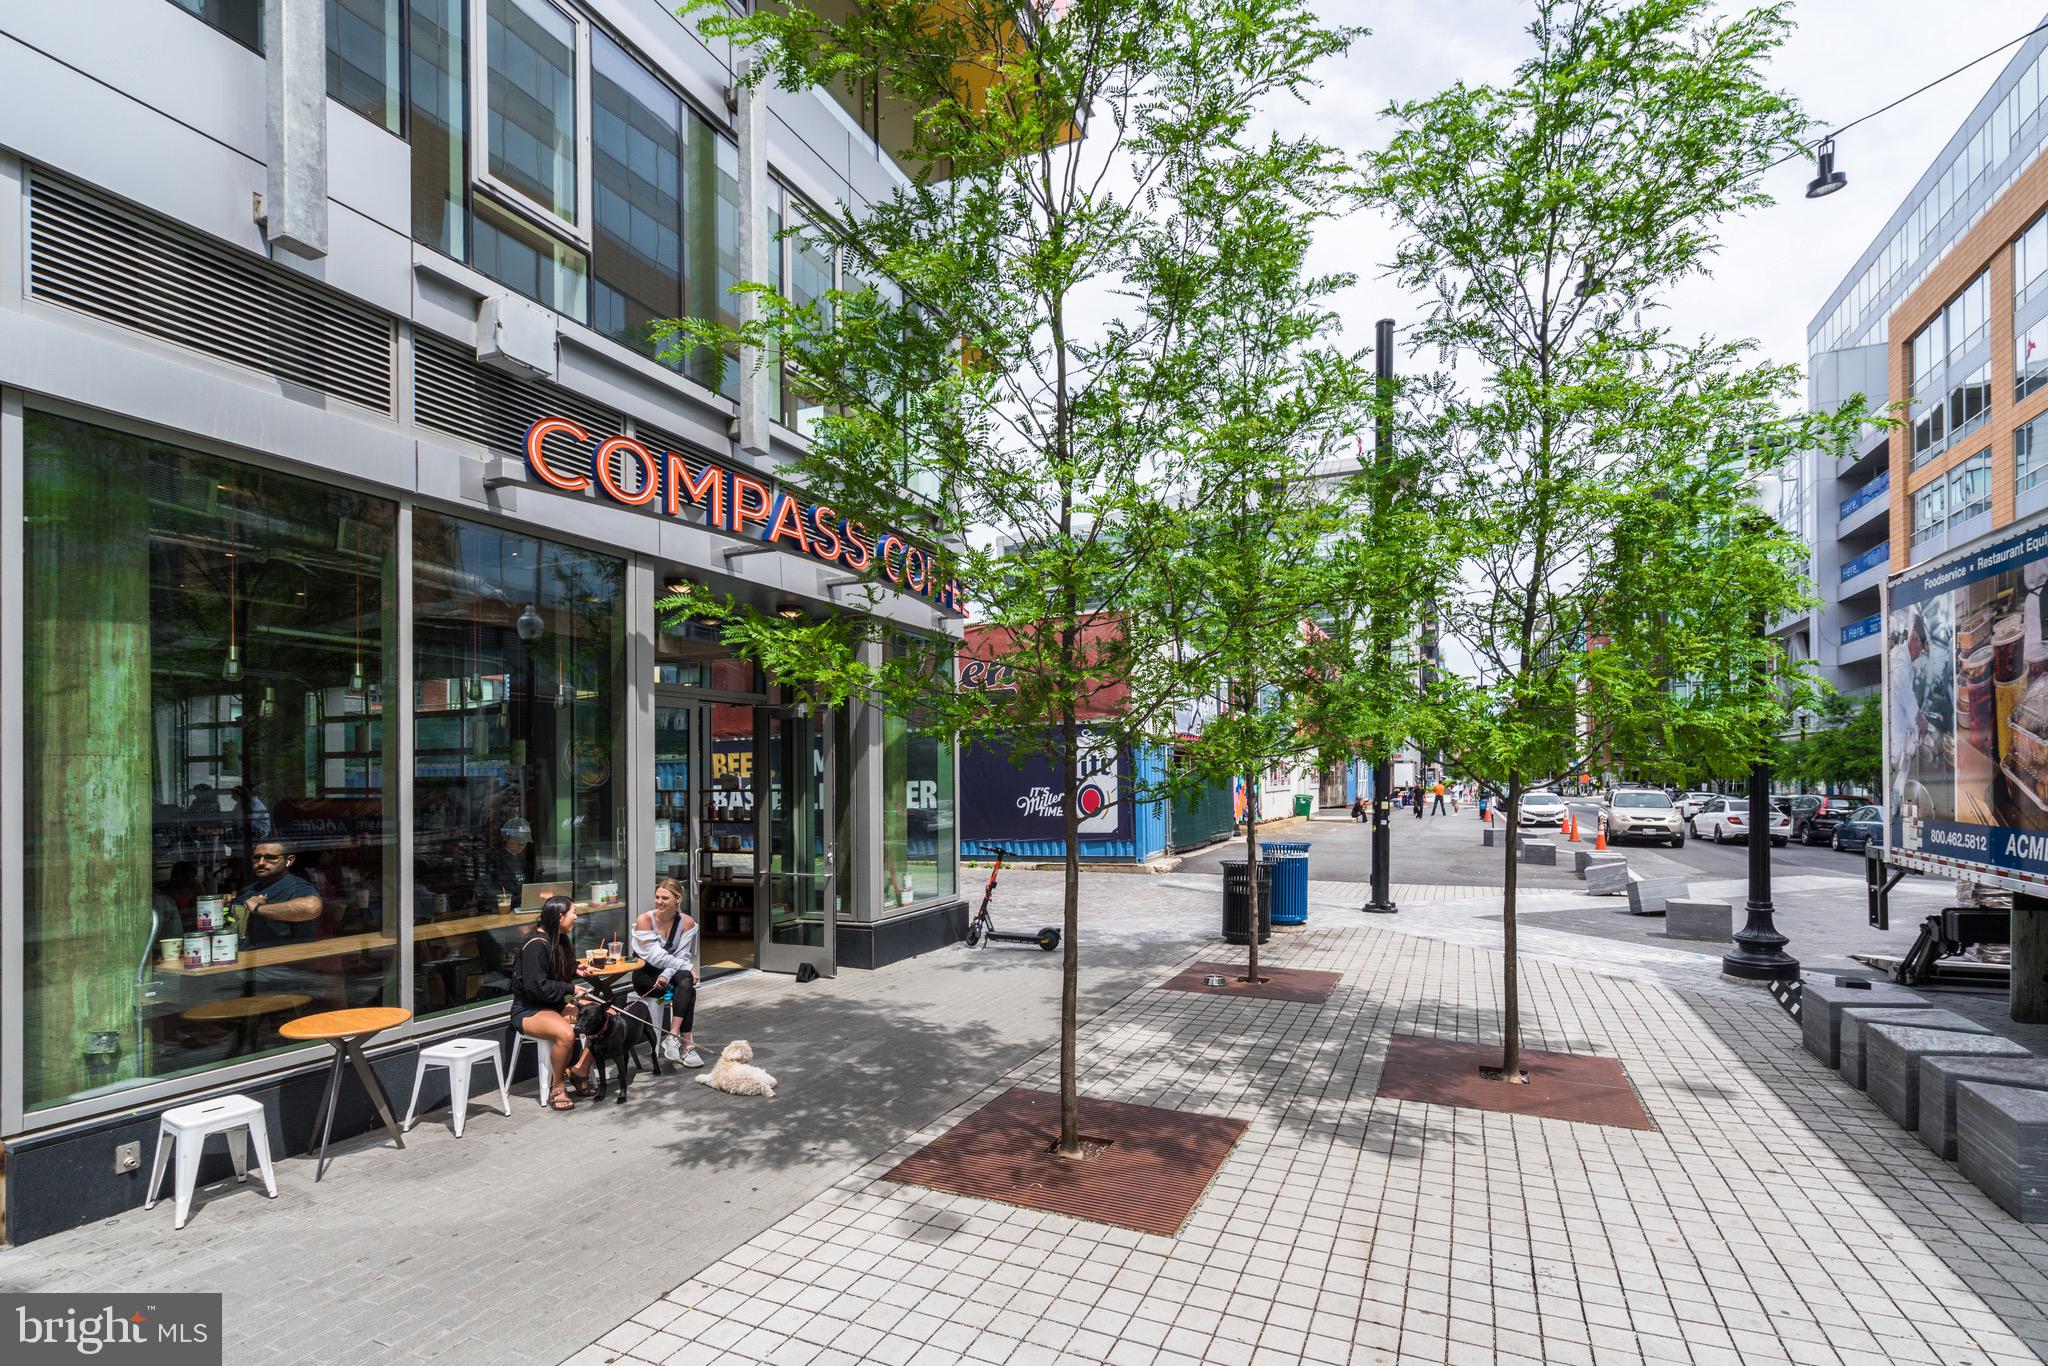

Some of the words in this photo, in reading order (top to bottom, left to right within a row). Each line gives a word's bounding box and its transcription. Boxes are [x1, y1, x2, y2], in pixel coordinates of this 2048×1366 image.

[523, 416, 869, 570] COMPASS
[1924, 564, 1966, 590] Foodservice
[1977, 541, 2025, 570] Restaurant
[1016, 792, 1066, 816] Miller
[1030, 787, 1050, 797] IT'S
[1930, 829, 1987, 851] 800.462.5812
